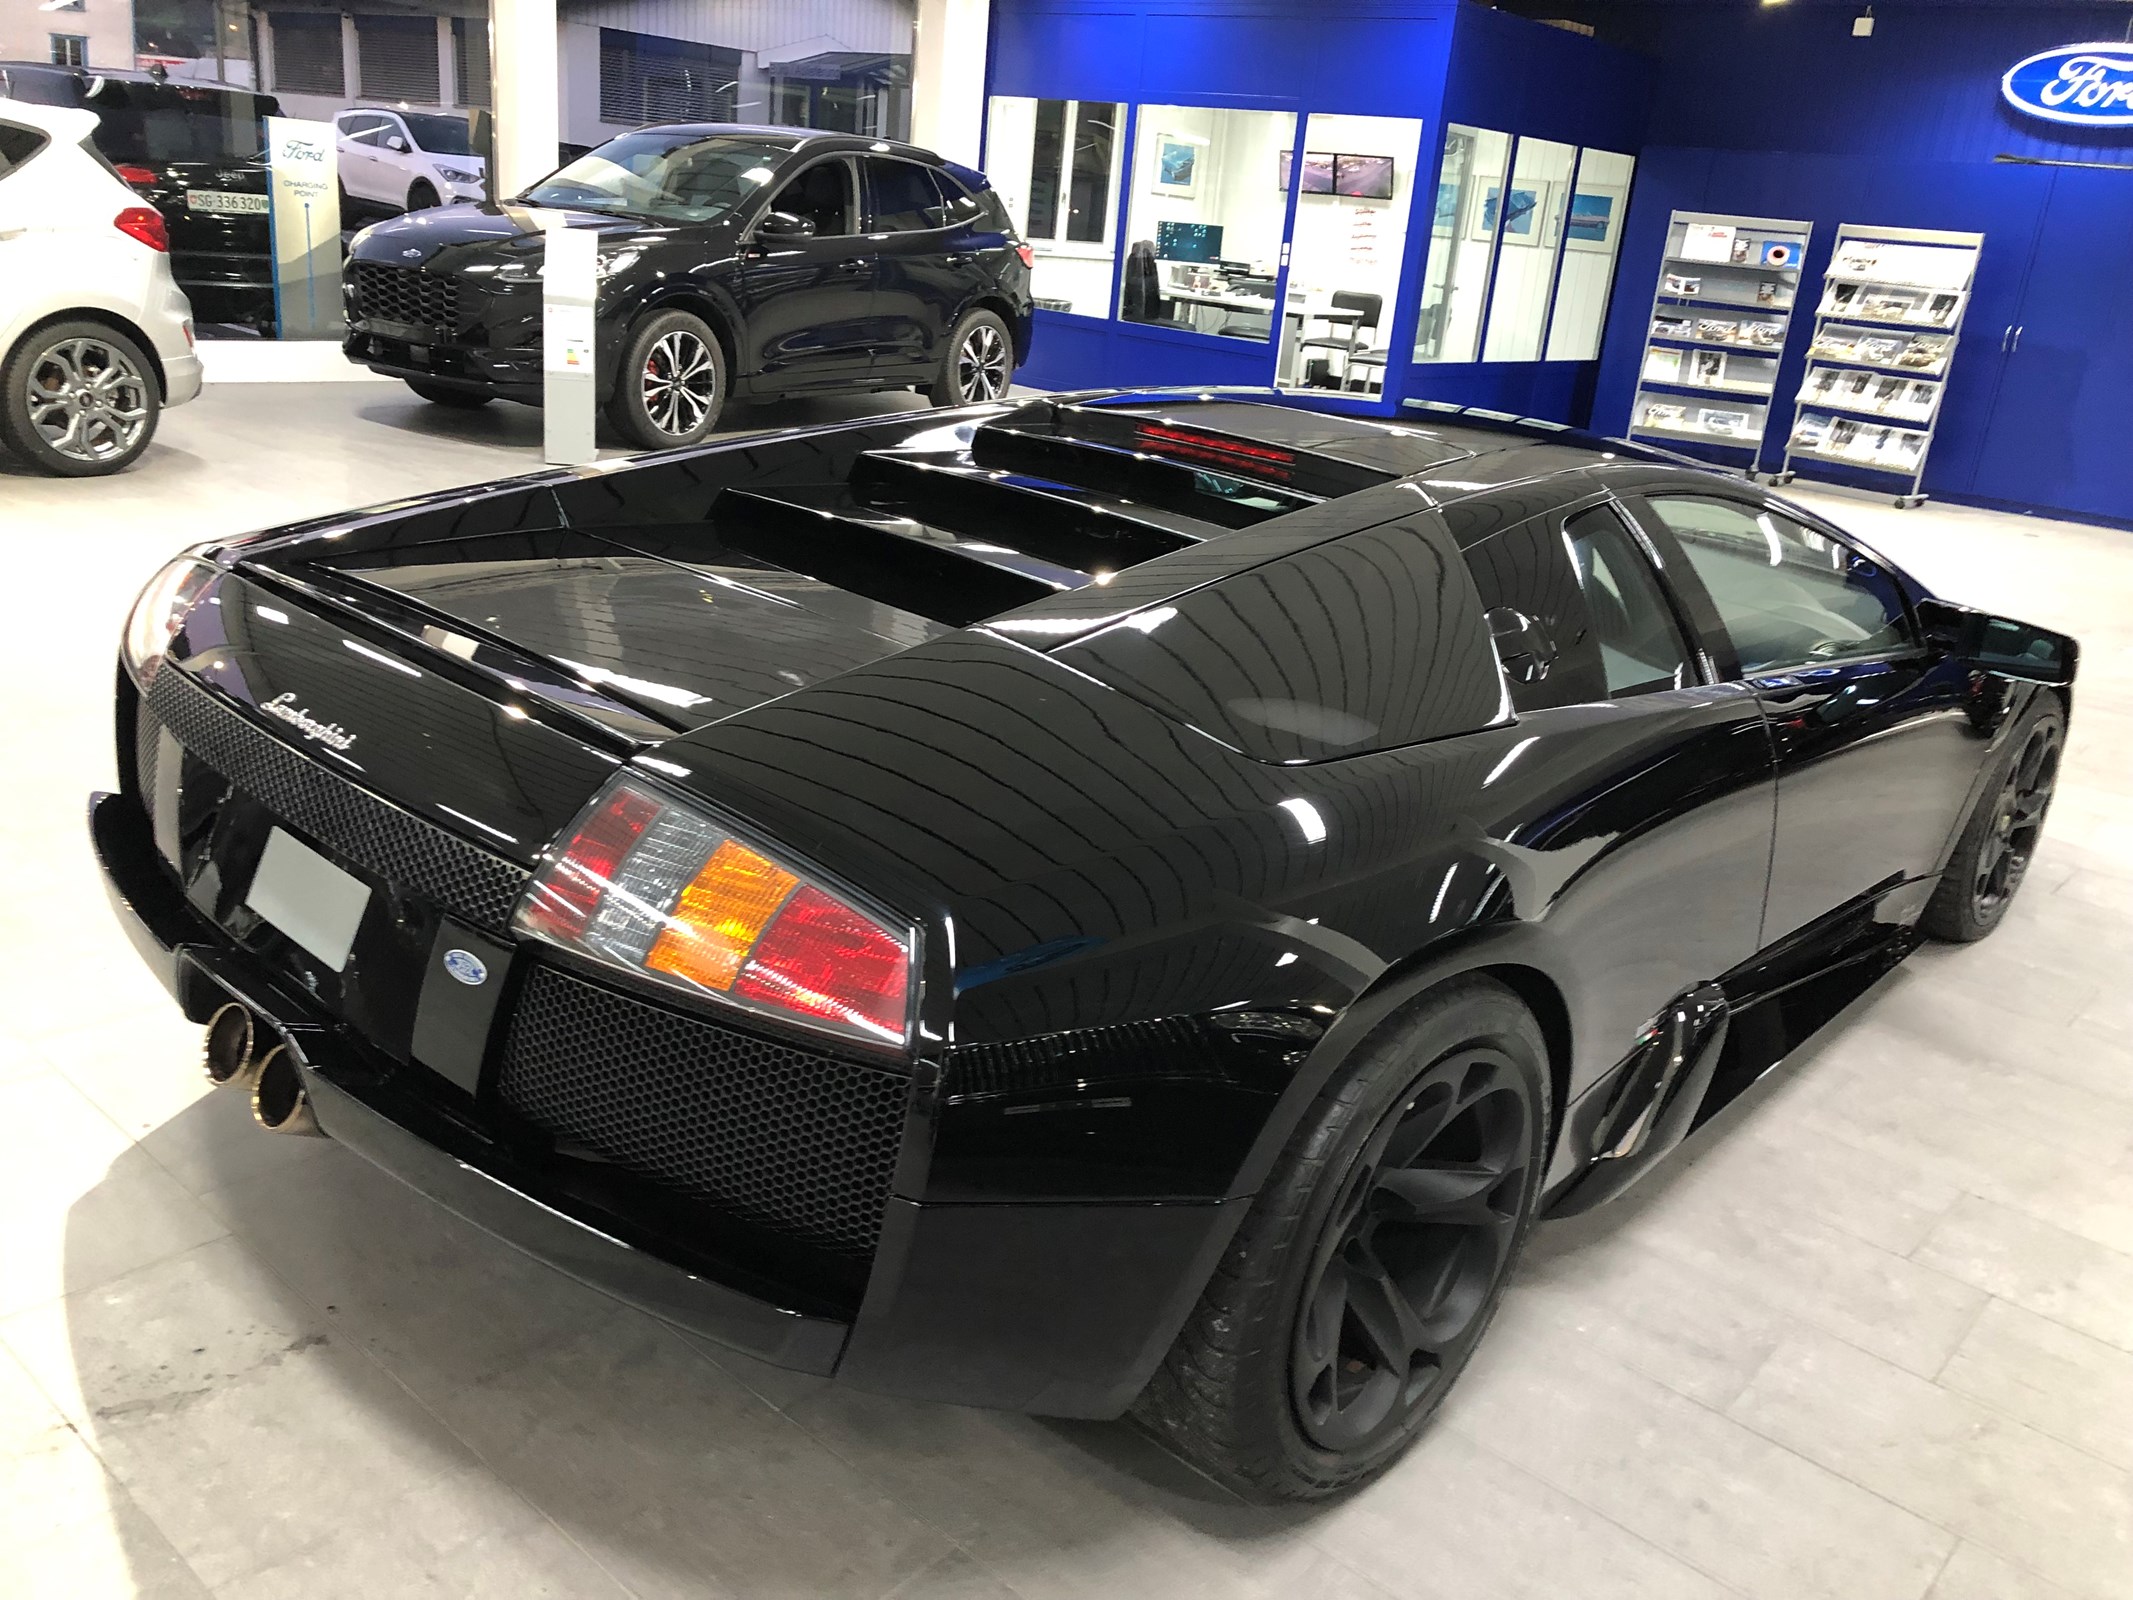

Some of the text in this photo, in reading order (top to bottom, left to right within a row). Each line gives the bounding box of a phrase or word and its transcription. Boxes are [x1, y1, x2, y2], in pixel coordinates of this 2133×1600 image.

[2040, 55, 2133, 110] For
[282, 139, 326, 162] Ford
[215, 169, 245, 180] Jeep
[283, 179, 329, 190] CHARGING
[293, 187, 319, 198] POINT
[260, 691, 358, 750] Lamborghini
